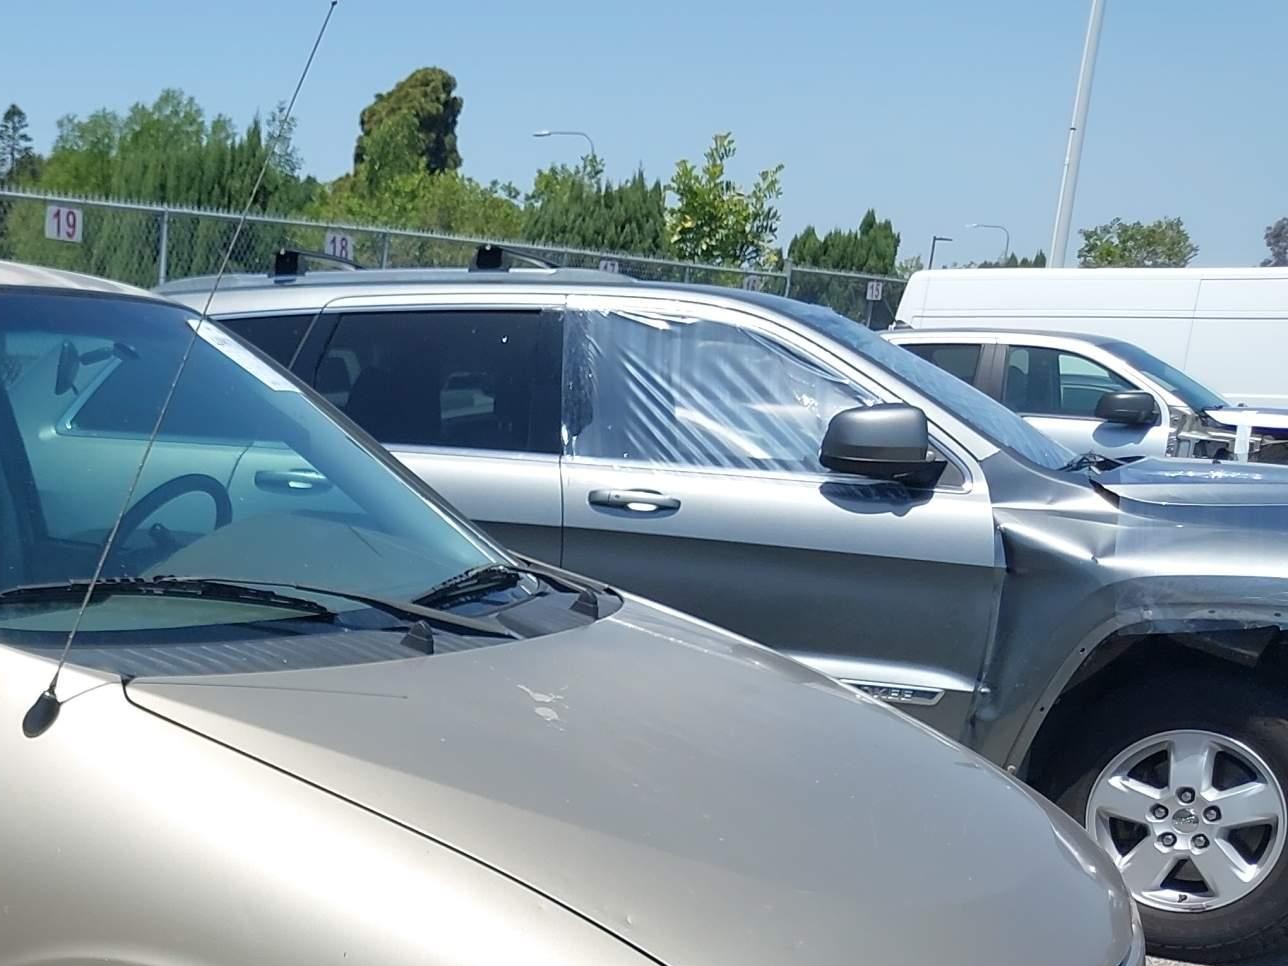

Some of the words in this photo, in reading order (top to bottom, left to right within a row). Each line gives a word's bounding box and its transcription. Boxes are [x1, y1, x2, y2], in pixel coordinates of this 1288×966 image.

[53, 208, 76, 240] 19
[329, 236, 348, 259] 18
[869, 283, 880, 298] 15
